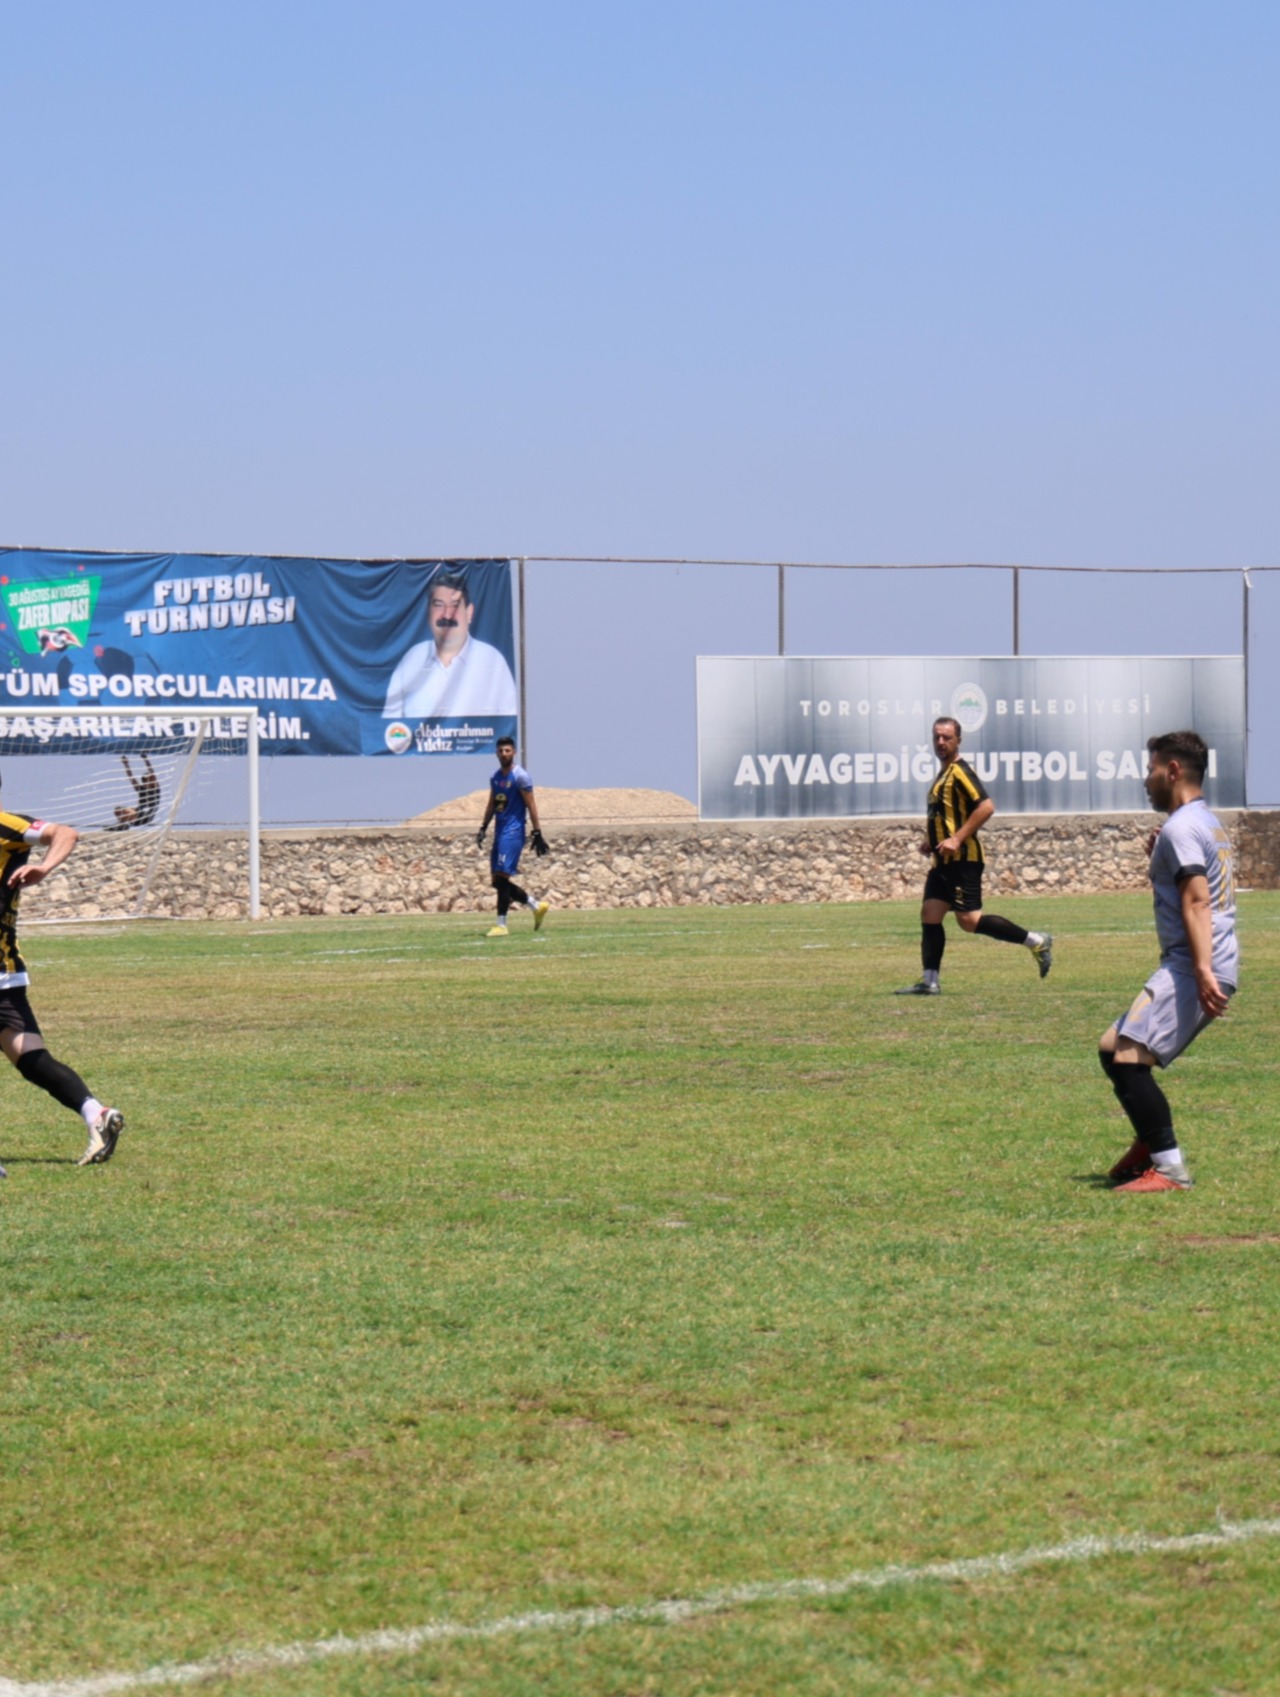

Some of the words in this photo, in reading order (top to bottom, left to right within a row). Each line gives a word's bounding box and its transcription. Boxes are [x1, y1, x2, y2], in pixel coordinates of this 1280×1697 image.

[153, 572, 271, 607] FUTBOL
[18, 603, 51, 630] ZAFER
[51, 597, 90, 625] KUPASI
[124, 596, 296, 638] TURNUVASI
[68, 674, 337, 701] SPORCULARIMIZA
[800, 700, 943, 717] TOROSLAR
[995, 694, 1151, 715] BELEDİYESİ
[414, 722, 495, 738] Abdurrahman
